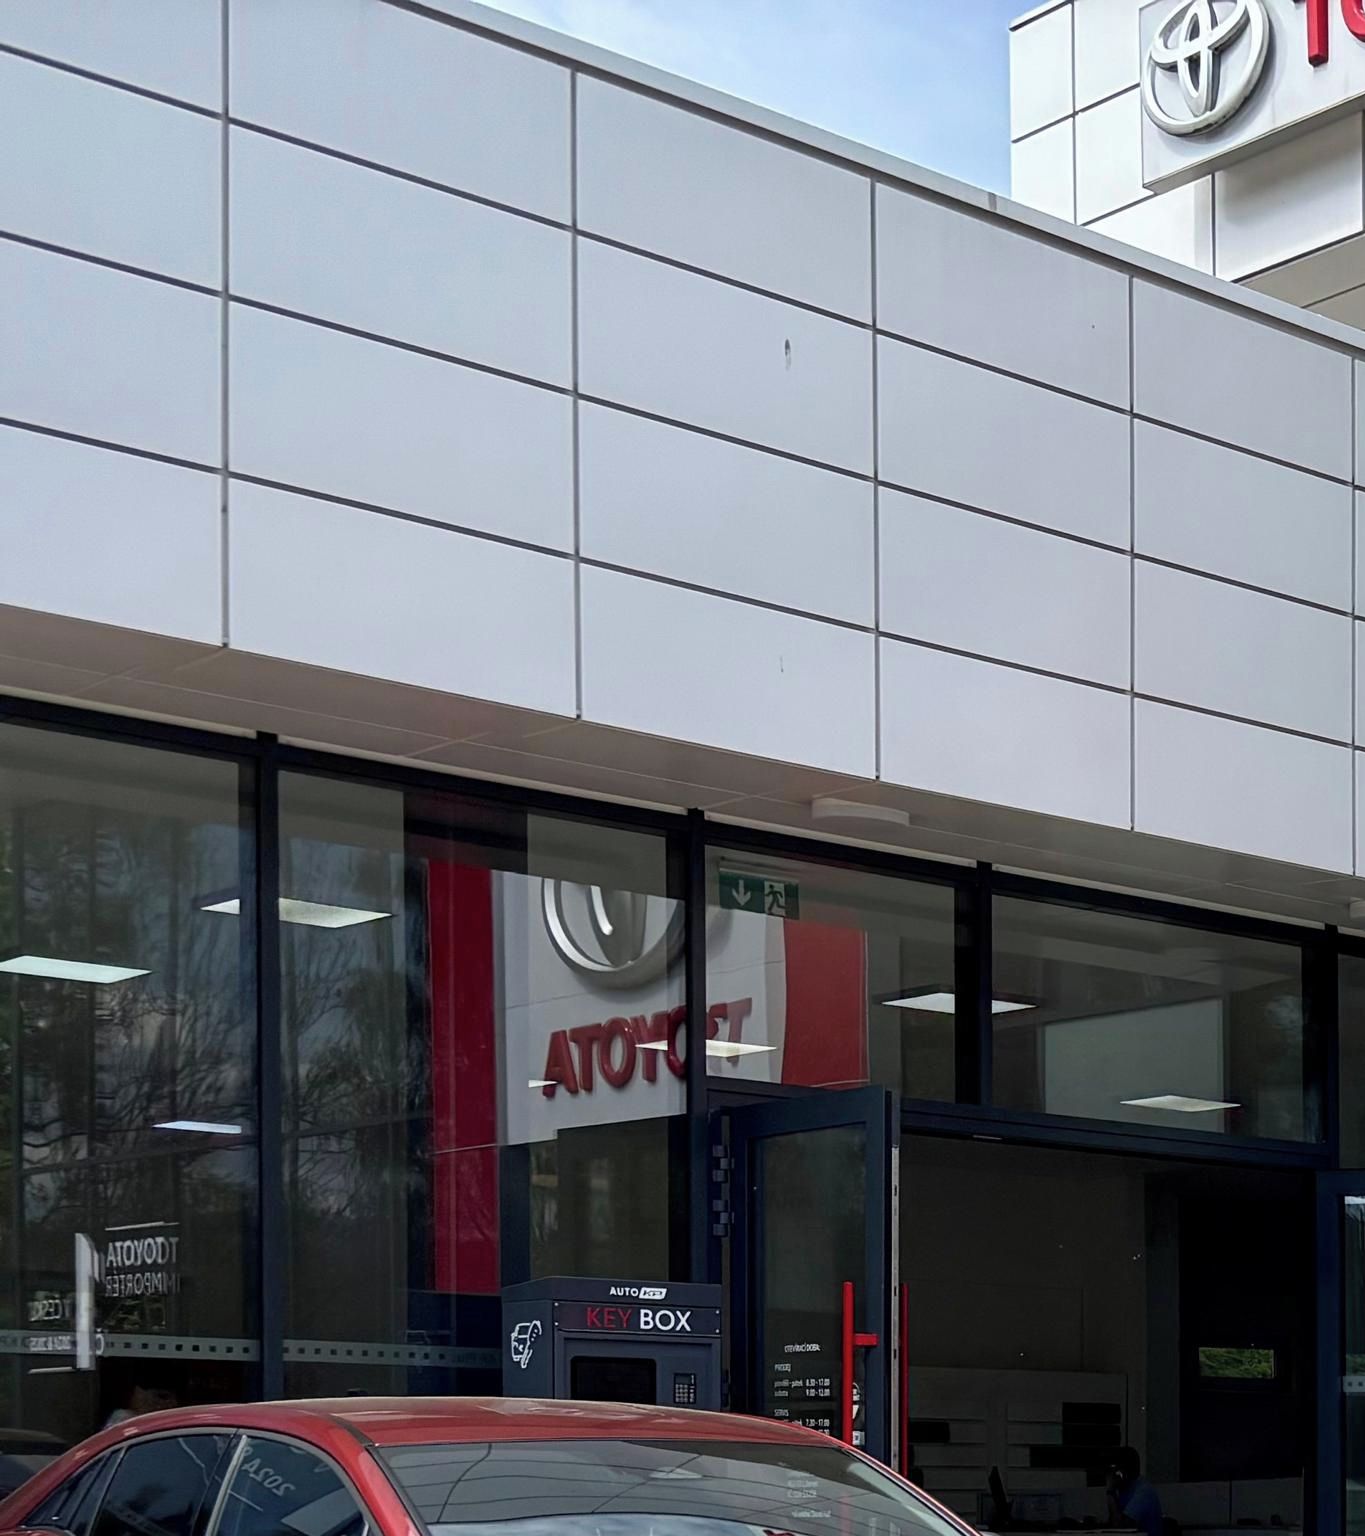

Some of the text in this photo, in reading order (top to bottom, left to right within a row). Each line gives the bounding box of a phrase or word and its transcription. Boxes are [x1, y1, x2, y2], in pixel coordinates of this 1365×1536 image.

[609, 1286, 639, 1298] AUTO
[586, 1307, 692, 1332] KEY BOX
